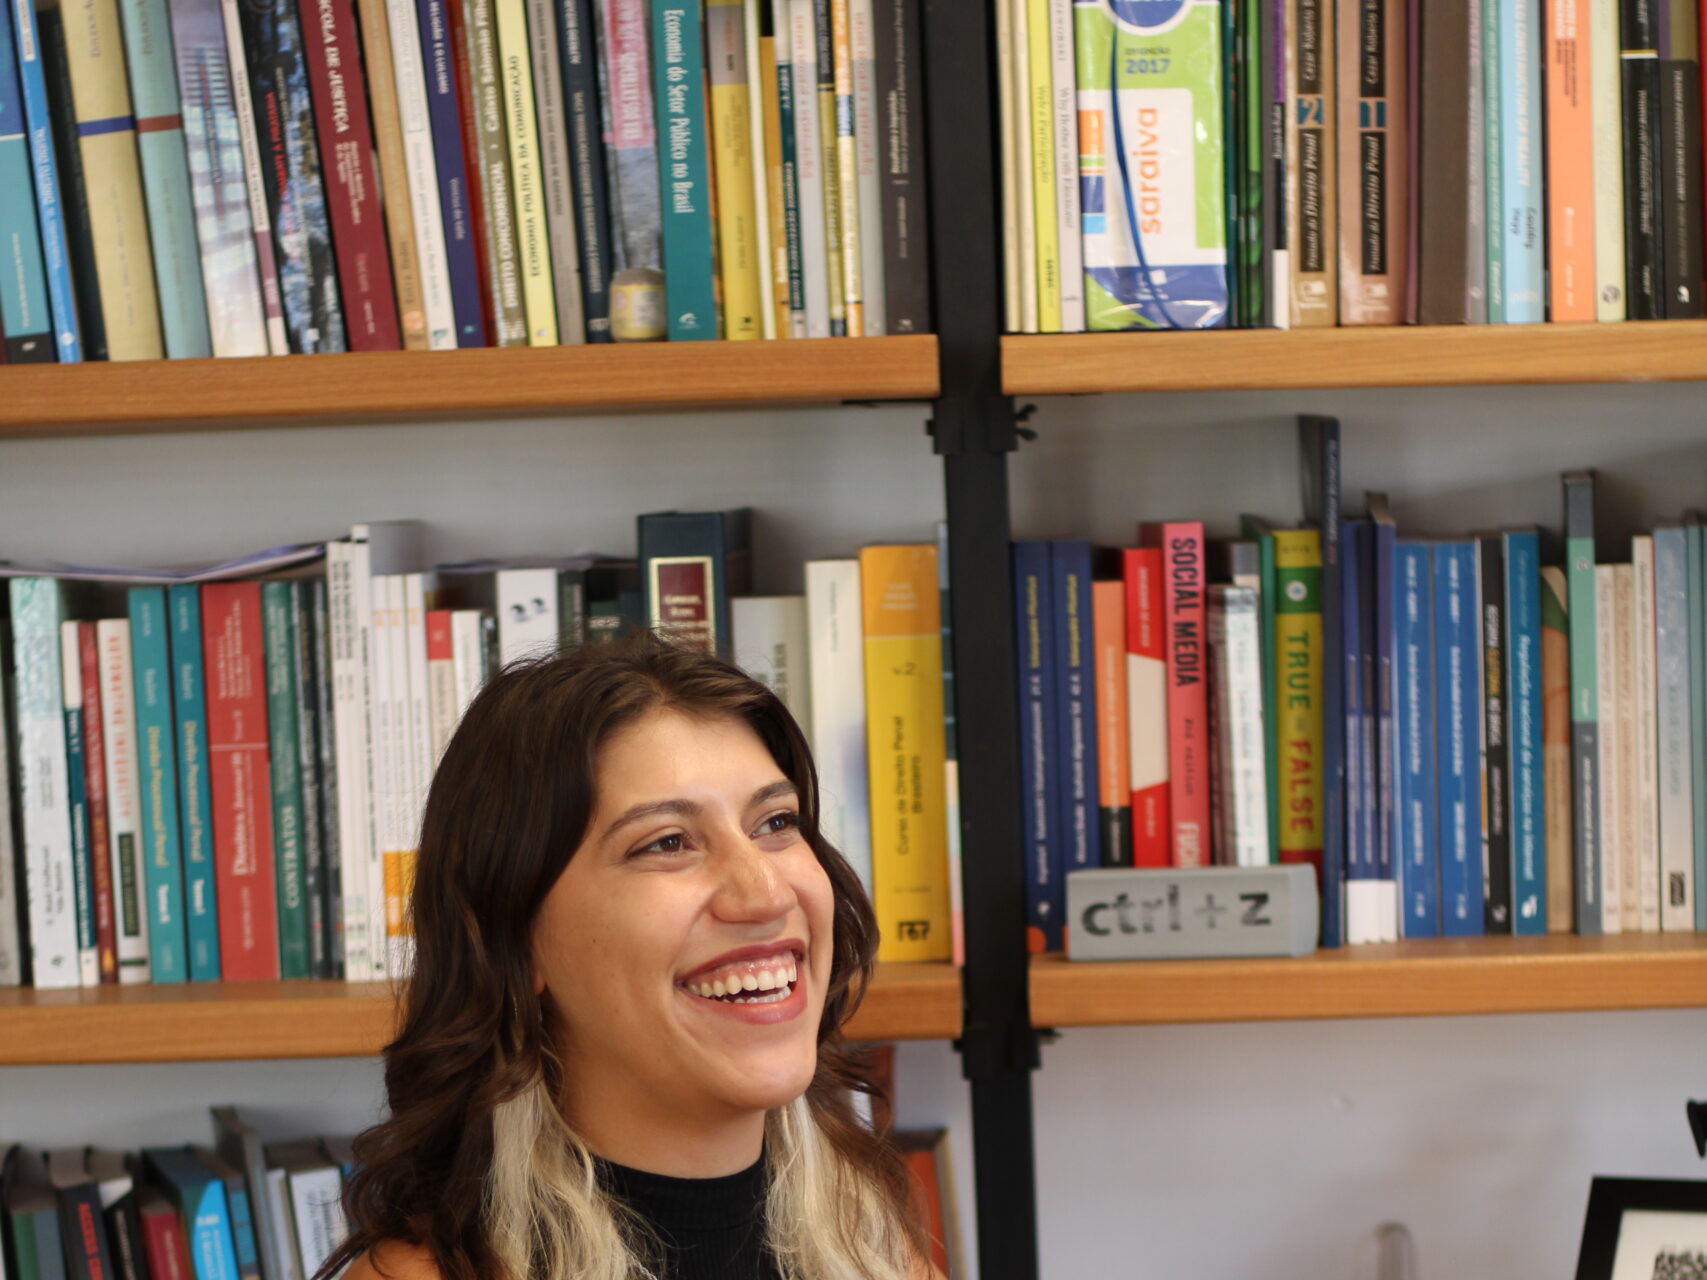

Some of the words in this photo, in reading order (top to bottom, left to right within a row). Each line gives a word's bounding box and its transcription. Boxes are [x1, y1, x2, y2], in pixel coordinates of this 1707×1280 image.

[664, 9, 687, 63] Economia
[1302, 9, 1315, 50] Roberto
[1364, 12, 1377, 53] Roberto
[325, 46, 340, 68] DE
[475, 30, 493, 83] Salomão
[666, 67, 686, 82] do
[1125, 58, 1170, 75] 2017
[1303, 53, 1317, 81] Cezar
[1365, 56, 1378, 84] Cezar
[328, 70, 350, 133] JUSTIÇA
[483, 87, 500, 131] Calixto
[508, 56, 526, 138] COMUNICAÇÃO
[667, 84, 690, 113] Setor
[1058, 87, 1070, 110] Why
[1299, 98, 1322, 125] 2
[35, 127, 49, 163] DIGITAL
[518, 143, 528, 158] DA
[669, 118, 694, 159] Público
[1303, 133, 1317, 169] Penal
[1365, 135, 1379, 172] Penal
[671, 163, 687, 178] no
[1132, 107, 1162, 235] saraiva
[1516, 136, 1530, 187] REALITY
[40, 166, 55, 205] DIREITO
[518, 163, 533, 213] POLÍTICA
[672, 181, 696, 213] Brasil
[1303, 171, 1318, 216] Direito
[1365, 174, 1380, 219] Direito
[491, 161, 515, 259] CONCORRENCIAL
[524, 218, 540, 277] ECONOMIA
[501, 261, 518, 307] DIREITO
[1171, 537, 1199, 613] SOCIAL
[1173, 622, 1200, 686] MEDIA
[1287, 631, 1311, 711] TRUE
[1517, 634, 1532, 696] Regulação
[108, 636, 127, 726] AUTOMATING
[893, 716, 905, 750] Penal
[1520, 699, 1532, 746] nacional
[113, 732, 131, 818] INEQUALITY
[894, 755, 907, 795] Direito
[909, 756, 924, 813] Brasileiro
[1184, 746, 1196, 797] edition
[1288, 740, 1314, 834] FALSE
[1519, 767, 1533, 812] serviços
[895, 799, 908, 814] de
[155, 833, 169, 866] Penal
[190, 829, 204, 862] Penal
[281, 805, 299, 909] CONTRATOS
[897, 819, 909, 854] Curso
[78, 1203, 99, 1255] ACCESS
